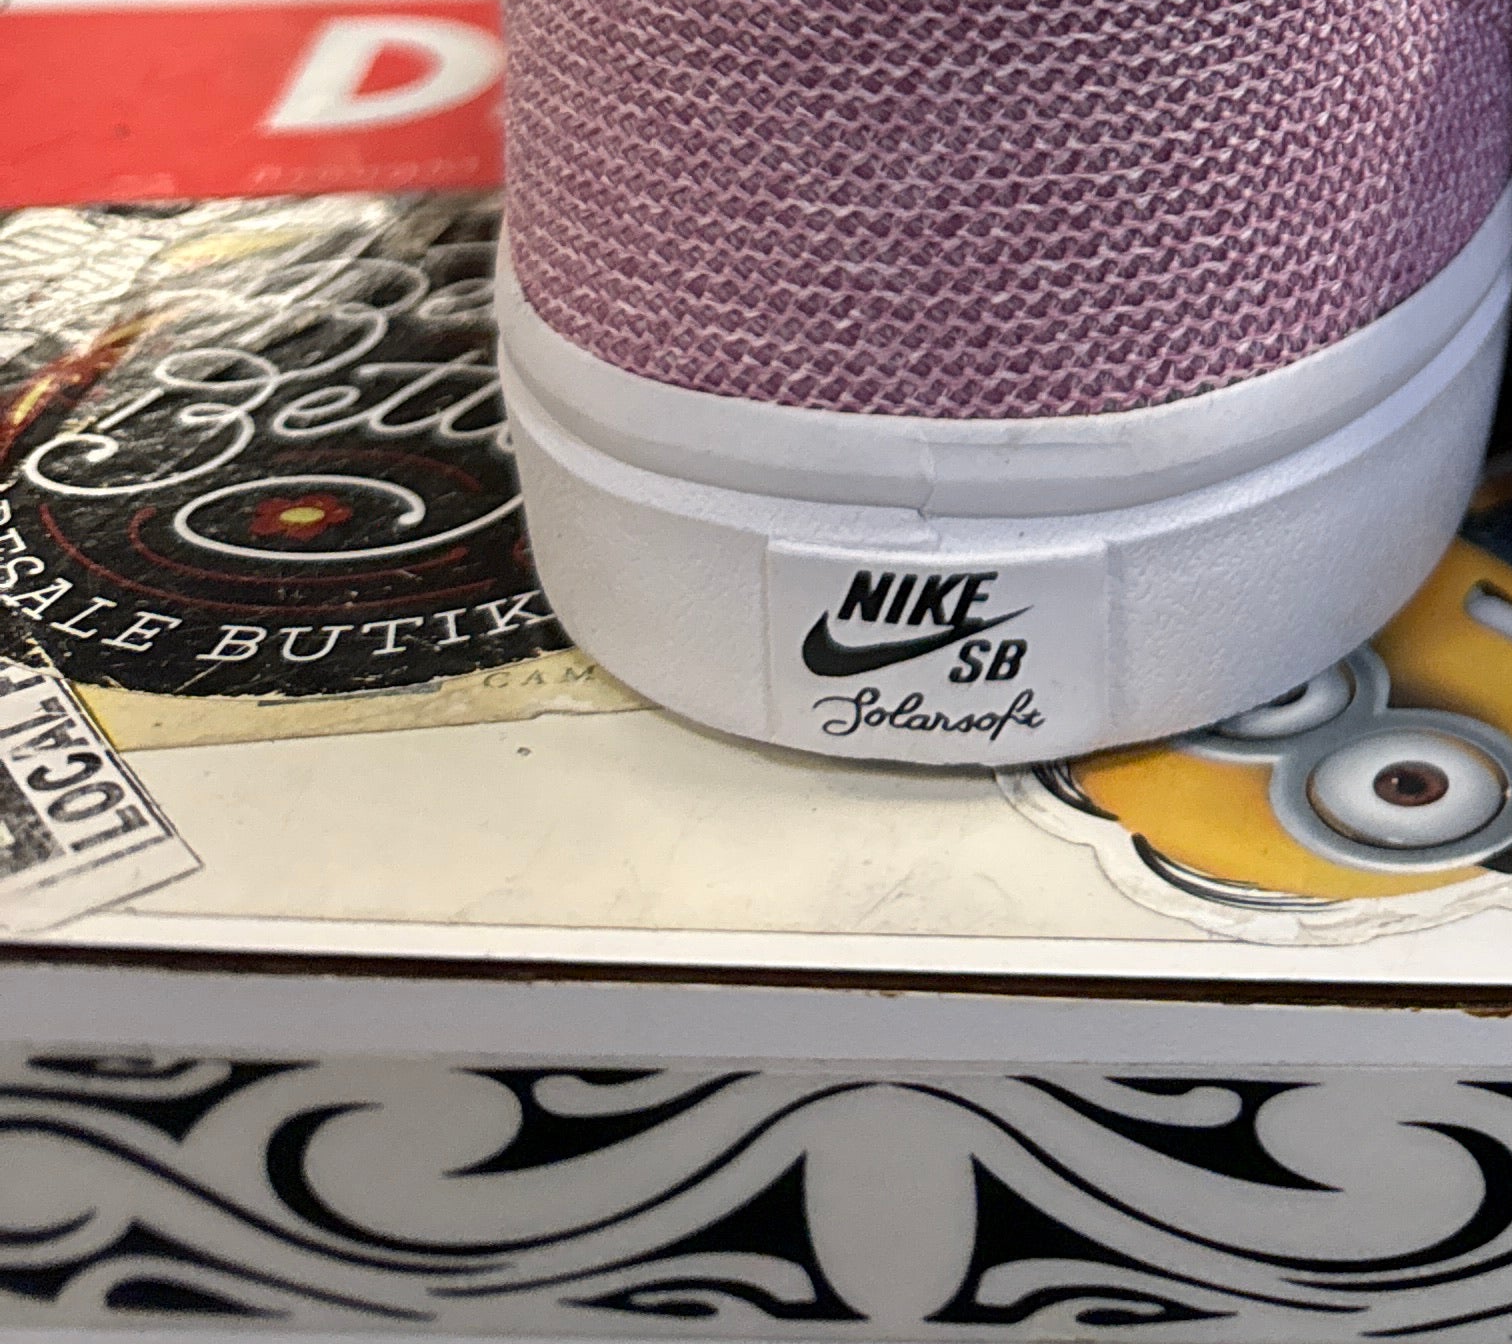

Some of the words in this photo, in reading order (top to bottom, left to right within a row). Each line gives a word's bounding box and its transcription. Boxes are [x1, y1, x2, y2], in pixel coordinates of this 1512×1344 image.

[262, 15, 505, 134] D
[27, 349, 512, 495] Bett
[837, 570, 998, 629] NIKE
[949, 639, 1027, 683] SB
[813, 687, 1046, 740] Solarsoft
[0, 695, 149, 853] LOCAL
